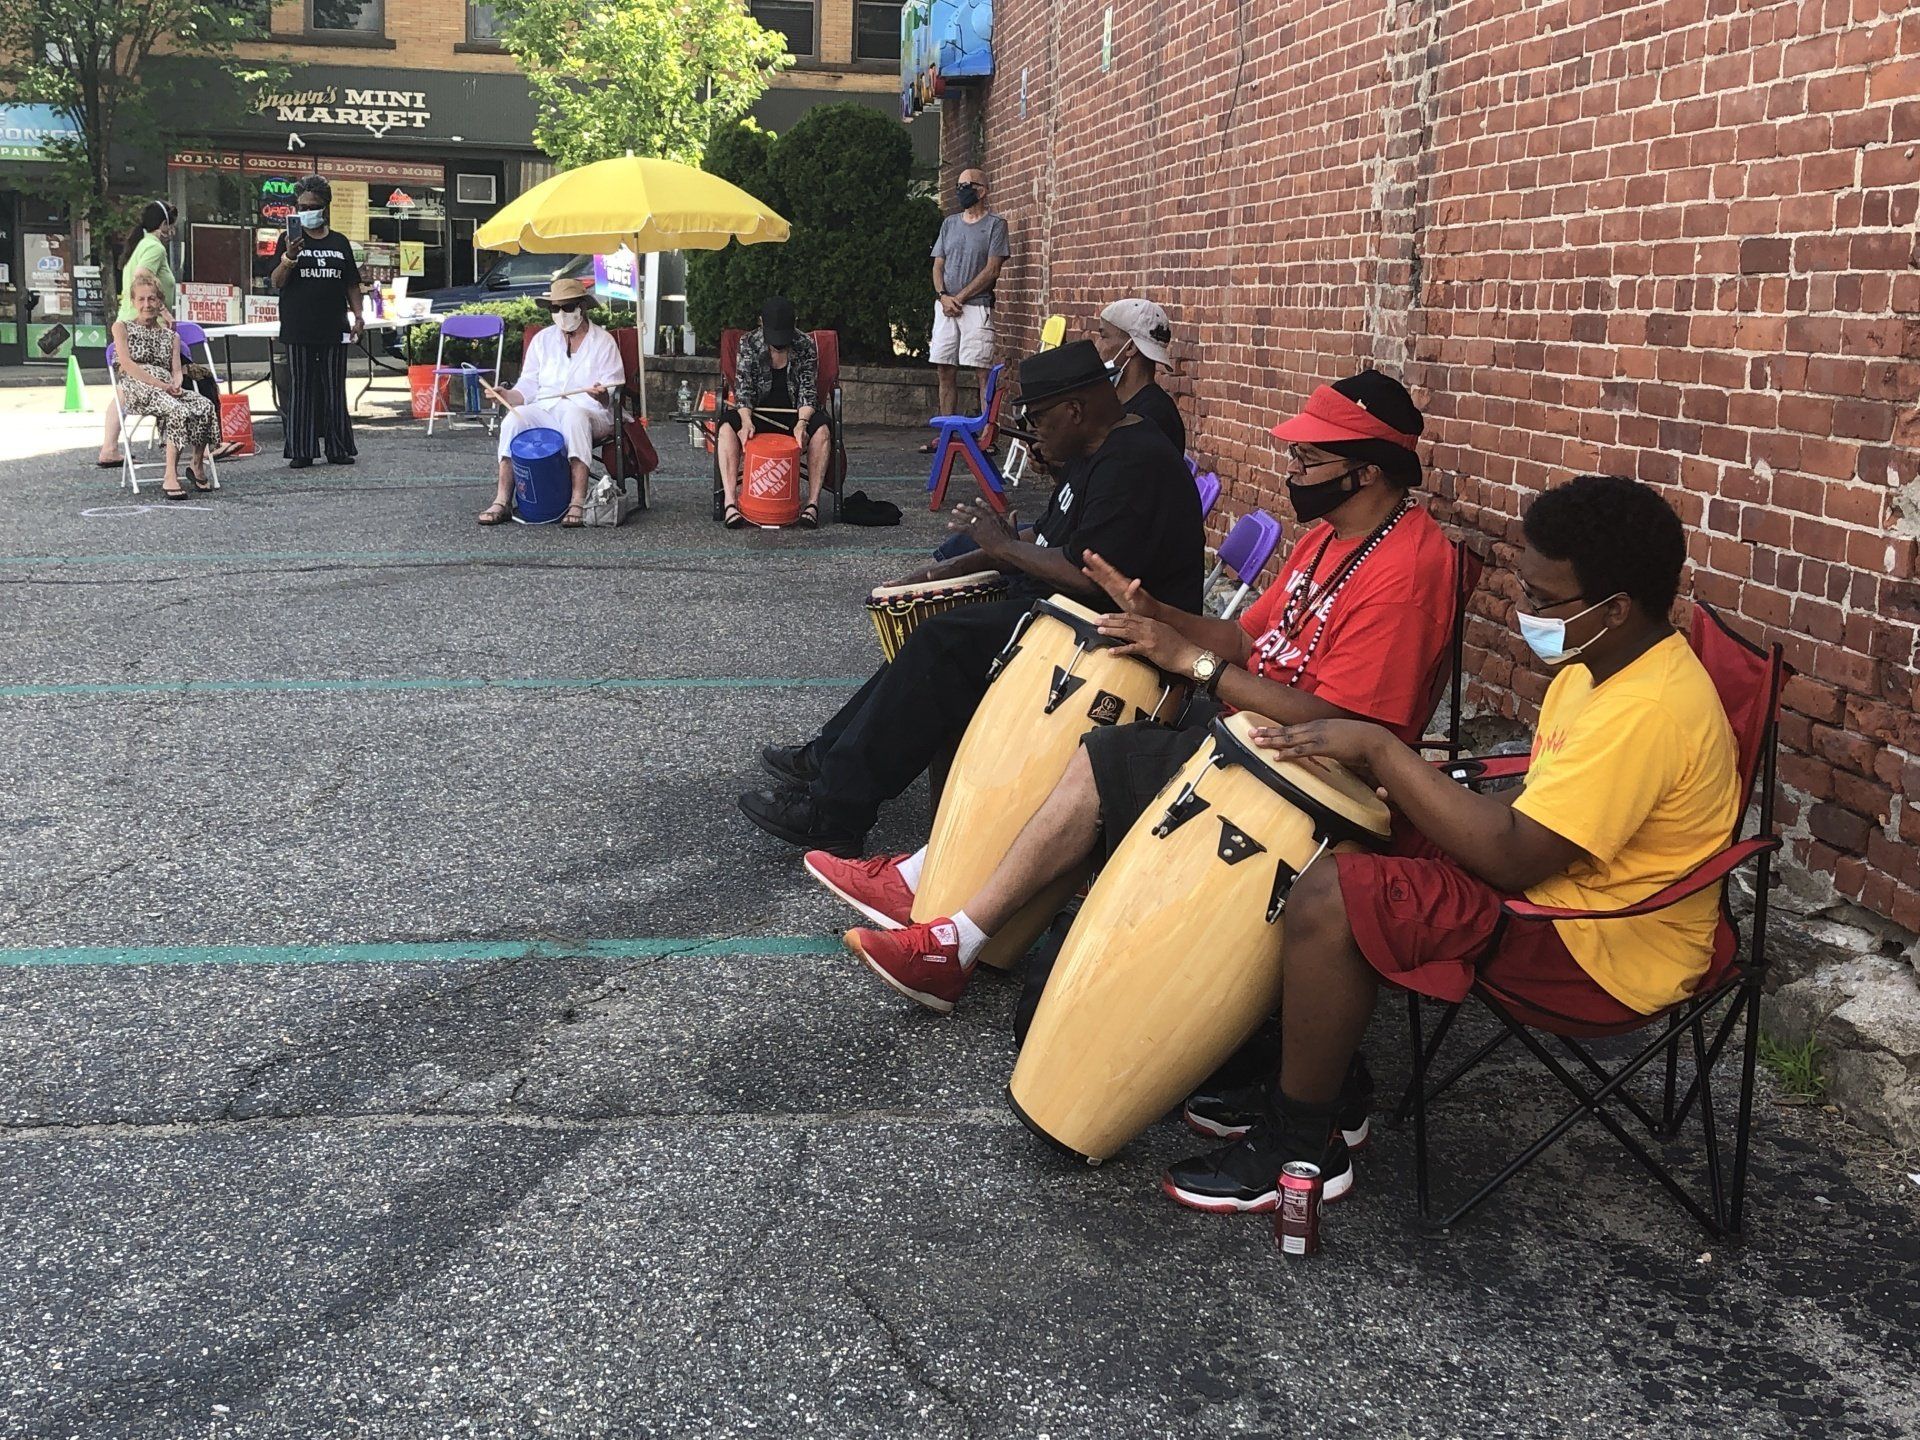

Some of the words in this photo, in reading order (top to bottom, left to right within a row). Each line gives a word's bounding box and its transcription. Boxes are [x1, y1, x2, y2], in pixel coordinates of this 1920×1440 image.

[345, 88, 426, 109] MINI
[276, 106, 431, 128] MARKET
[336, 162, 384, 174] LOTTO
[387, 166, 399, 175] &
[402, 167, 442, 177] MORE
[262, 180, 295, 195] ATM
[262, 205, 297, 218] OPEN
[313, 249, 345, 260] CULTURE
[317, 258, 326, 267] IS
[300, 268, 342, 279] BEAUTIFUL
[188, 300, 227, 312] TOBACCO
[254, 306, 277, 316] FOOD
[196, 311, 227, 322] CIGARS
[750, 459, 791, 497] HOME
